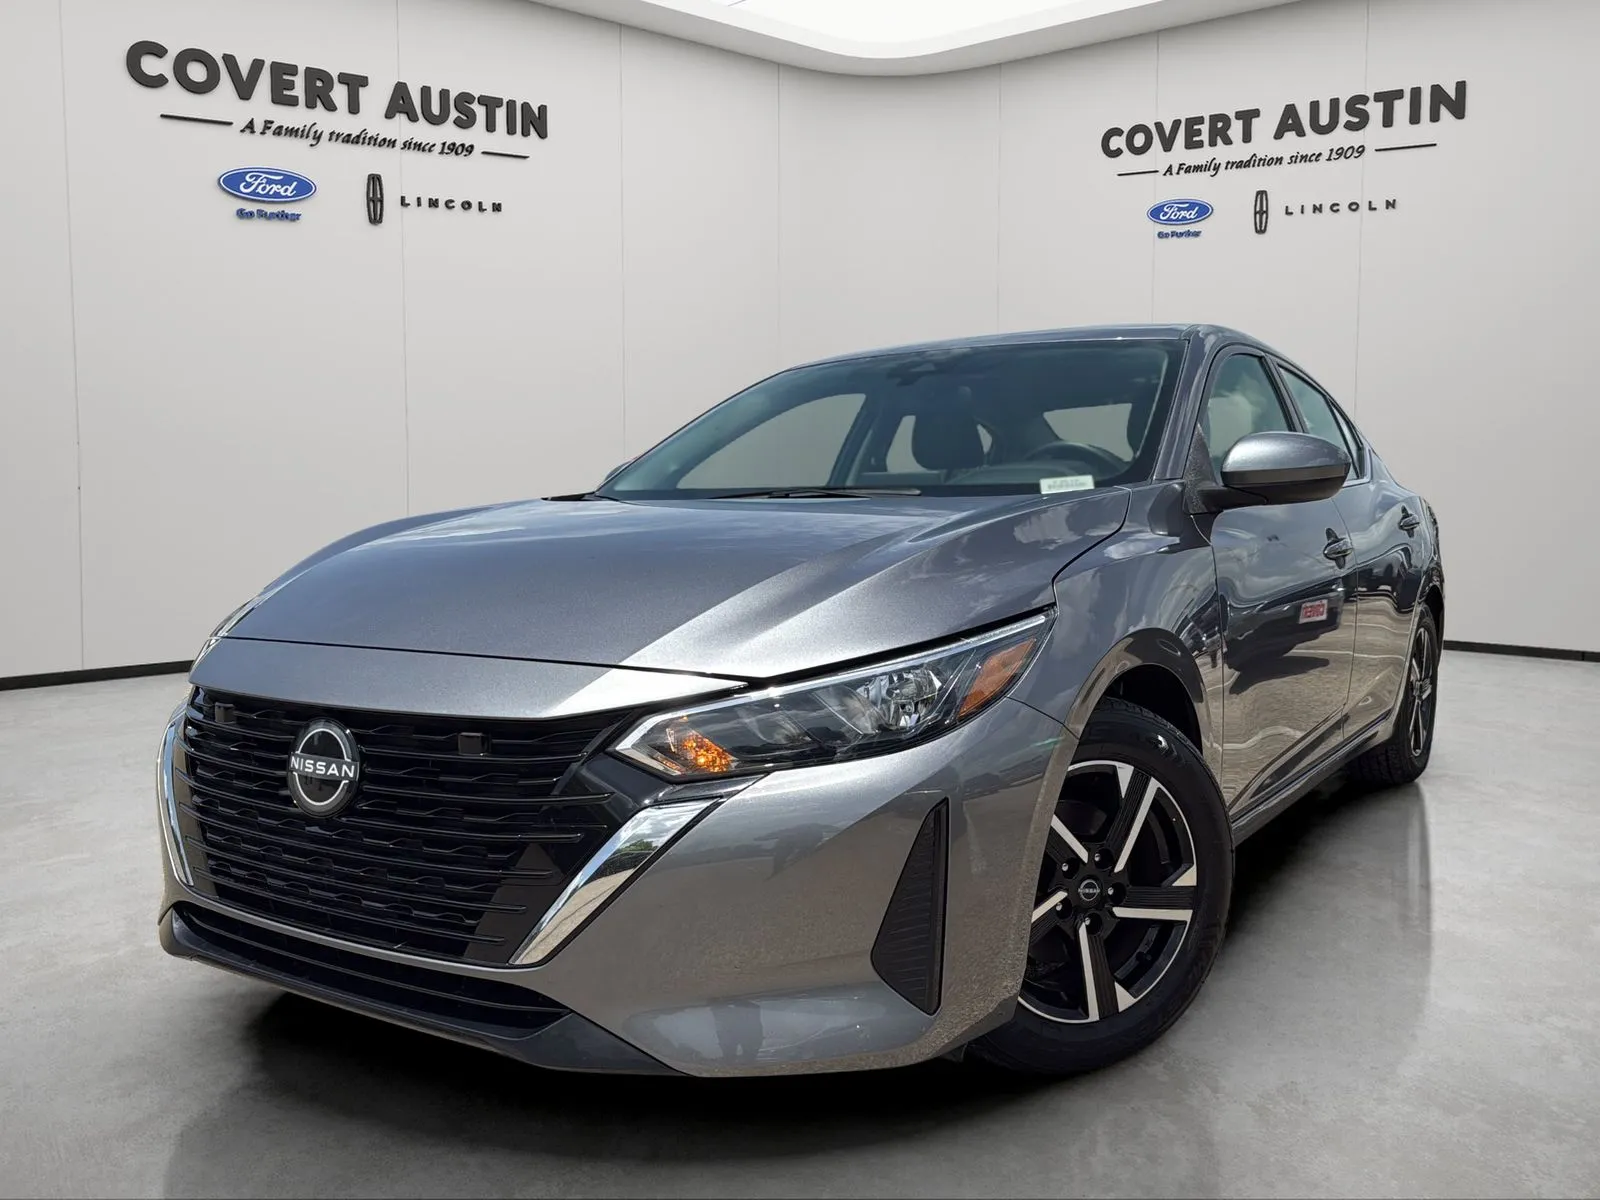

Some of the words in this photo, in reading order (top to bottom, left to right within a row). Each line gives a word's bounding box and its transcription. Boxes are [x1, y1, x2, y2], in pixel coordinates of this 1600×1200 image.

[126, 40, 369, 114] COVERT
[384, 81, 549, 140] AUSTIN
[1101, 107, 1261, 158] COVERT
[1273, 80, 1467, 140] AUSTIN
[240, 118, 256, 134] A
[260, 119, 324, 147] Family
[328, 128, 397, 149] tradition
[400, 137, 436, 154] since
[437, 140, 475, 157] 1909
[1163, 164, 1174, 176] A
[1176, 157, 1222, 177] Family
[1224, 153, 1284, 171] tradition
[1287, 150, 1323, 165] since
[1325, 145, 1365, 162] 1909
[239, 172, 298, 197] Ford
[400, 195, 503, 213] LINCOLN
[1160, 203, 1200, 220] Ford
[1285, 198, 1397, 216] LINCOLN
[290, 756, 355, 778] NISSAN
